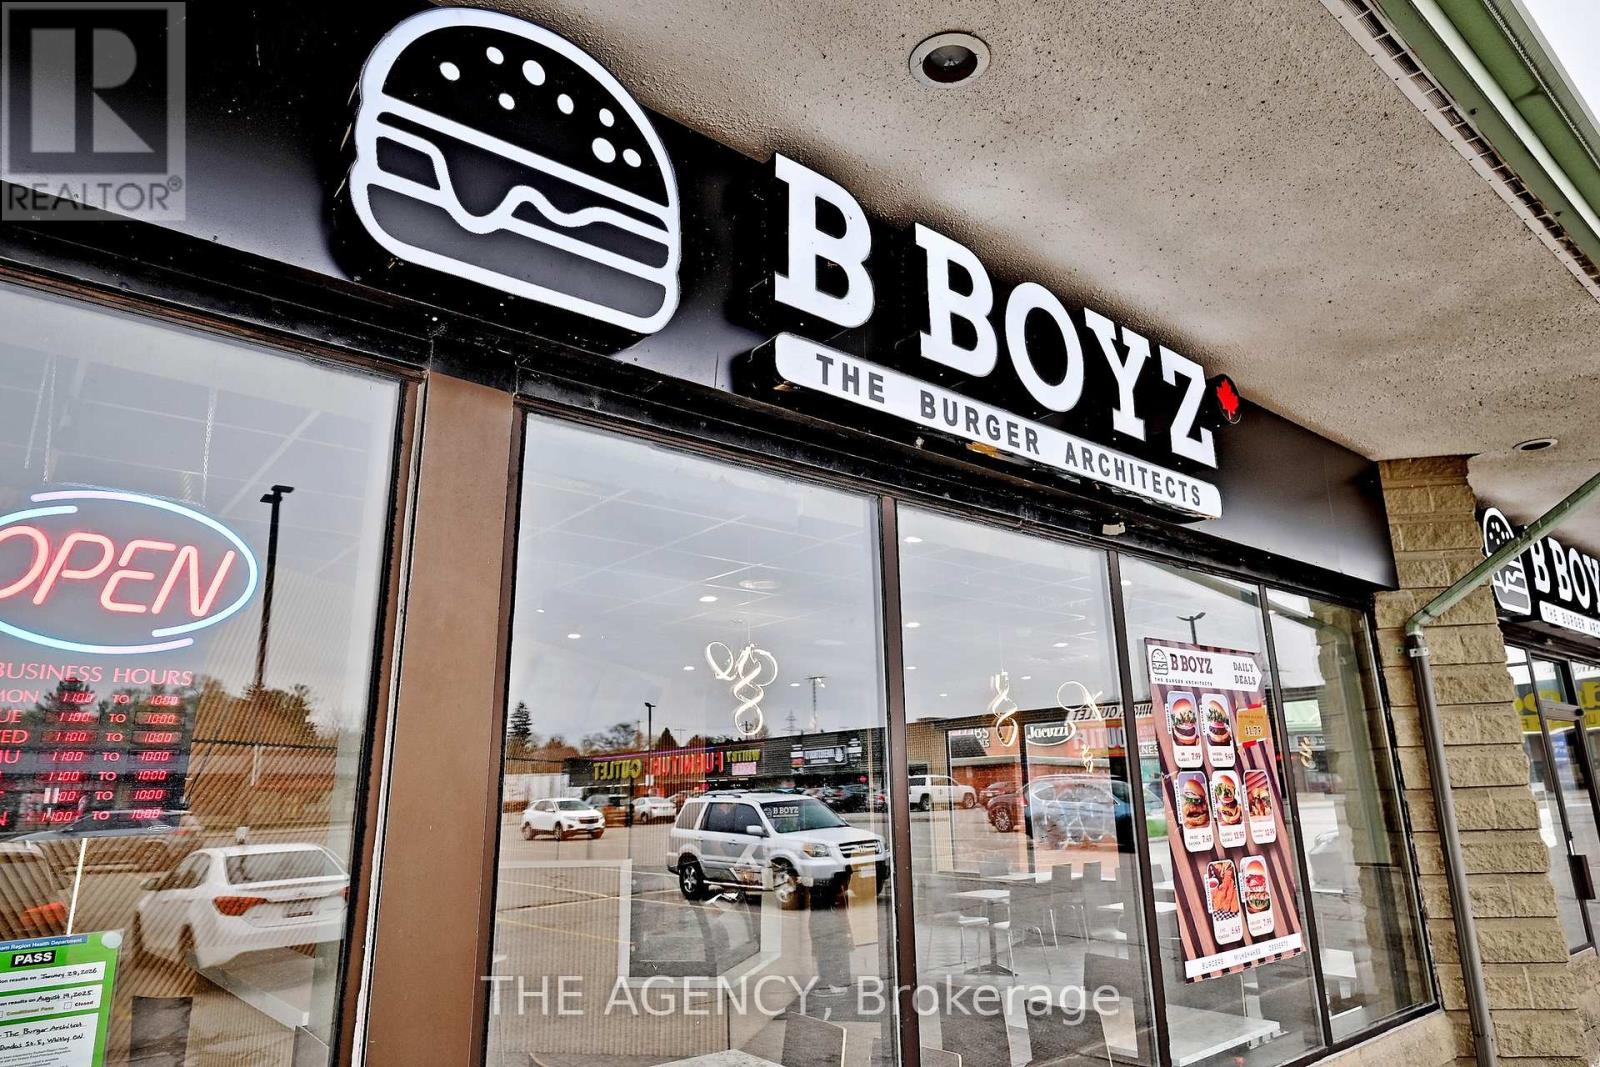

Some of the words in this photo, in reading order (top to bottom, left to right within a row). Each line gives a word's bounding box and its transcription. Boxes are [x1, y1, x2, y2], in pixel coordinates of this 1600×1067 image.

[775, 152, 875, 329] B
[915, 222, 1218, 469] BOYZ
[816, 353, 886, 404] THE
[920, 390, 1041, 456] BURGER
[1064, 441, 1202, 507] ARCHITECTS
[0, 526, 235, 617] OPEN
[1530, 540, 1551, 594] B
[1170, 653, 1179, 671] B
[1180, 655, 1213, 674] BOYZ
[1233, 661, 1254, 673] DAILY
[112, 667, 193, 687] HOURS
[1234, 674, 1257, 686] DEALS
[112, 694, 129, 704] TO
[0, 709, 22, 723] UE
[109, 713, 126, 723] TO
[0, 729, 29, 744] ED
[106, 732, 123, 742] TO
[1027, 723, 1069, 739] Jacuzzi
[102, 752, 120, 762] TO
[98, 771, 117, 781] TO
[95, 791, 113, 800] TO
[92, 810, 110, 820] TO
[773, 807, 779, 815] B
[780, 806, 799, 814] BOYZ
[14, 952, 53, 965] PASS
[36, 995, 60, 1003] August
[23, 1027, 48, 1036] Burger
